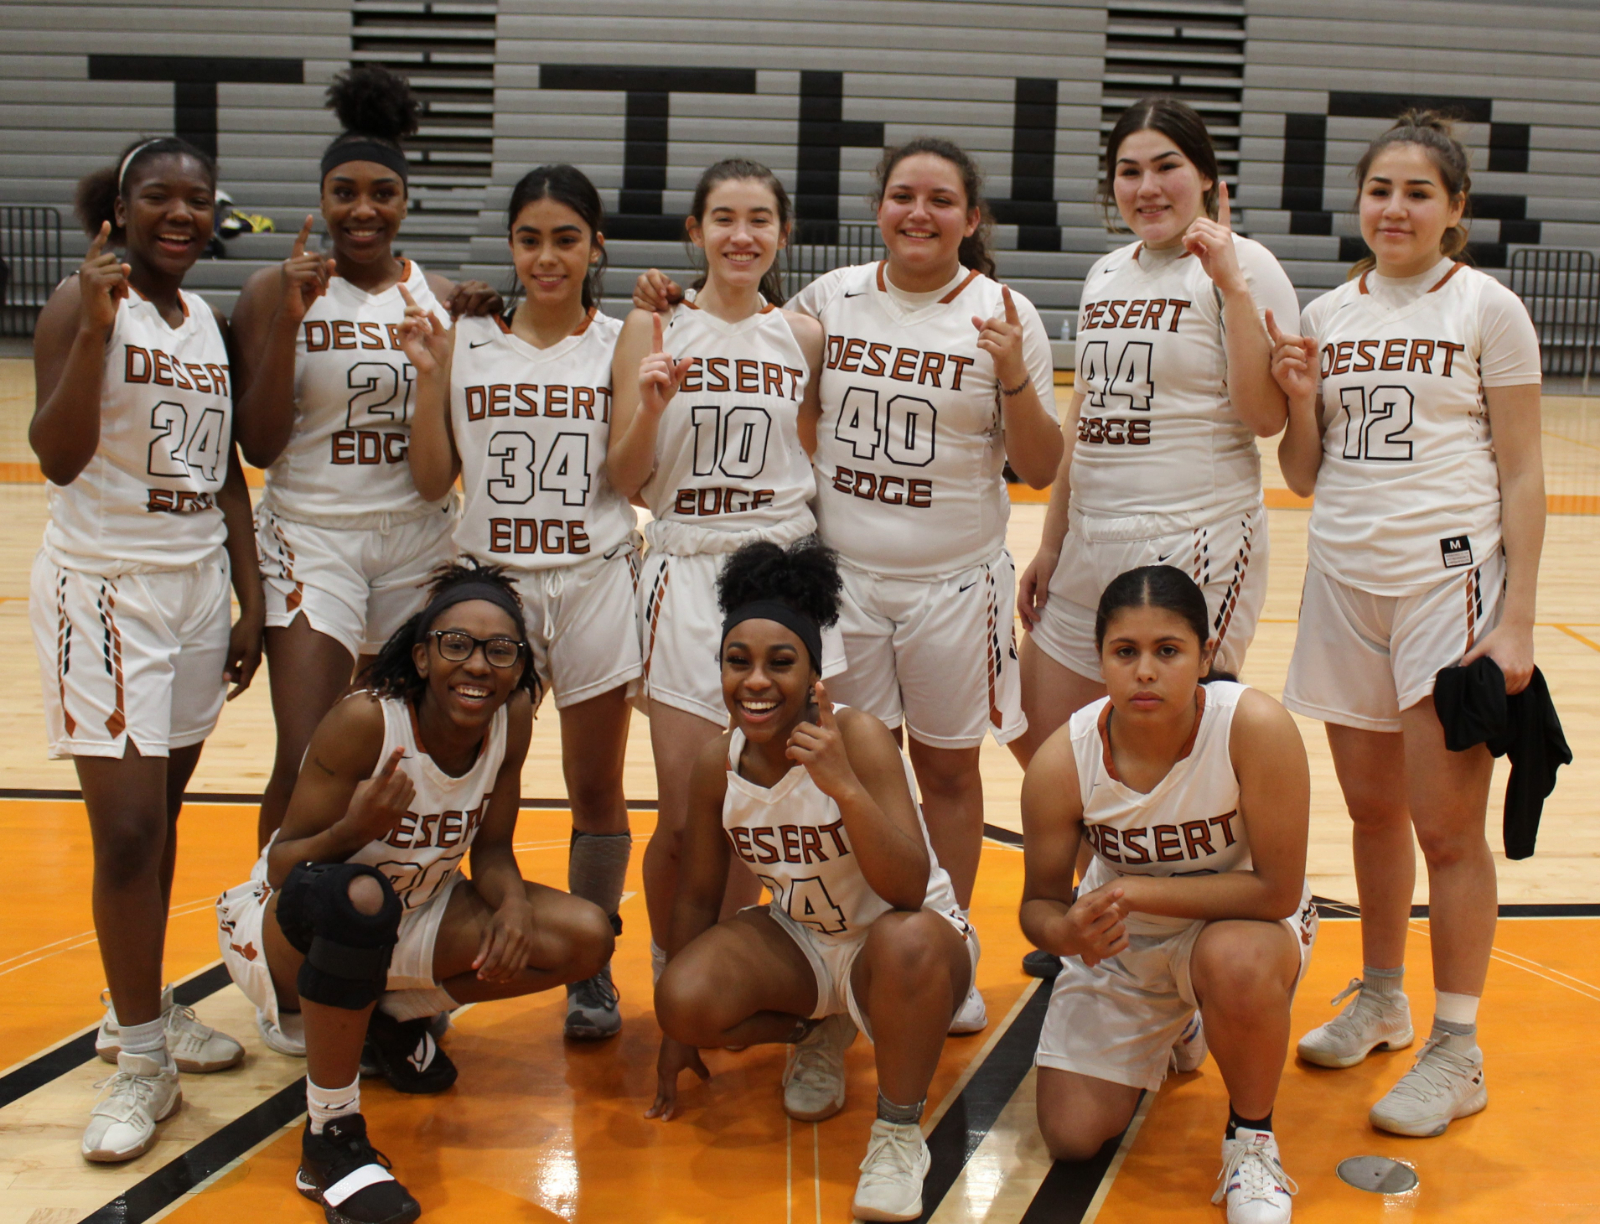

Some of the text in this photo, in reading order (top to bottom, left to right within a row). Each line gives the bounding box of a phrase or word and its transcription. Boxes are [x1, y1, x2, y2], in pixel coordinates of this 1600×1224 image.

[303, 320, 404, 352] DESE
[673, 357, 803, 402] ESERT
[826, 334, 975, 391] DESERT
[1081, 341, 1154, 411] 44
[147, 400, 225, 481] 24
[331, 430, 410, 465] EDG
[692, 406, 771, 480] 10
[834, 386, 937, 467] 40
[1340, 385, 1414, 461] 12
[487, 430, 590, 506] 34
[832, 465, 933, 508] EDGE
[488, 518, 590, 555] EDGE
[1449, 539, 1462, 550] M
[723, 818, 851, 864] ESERT
